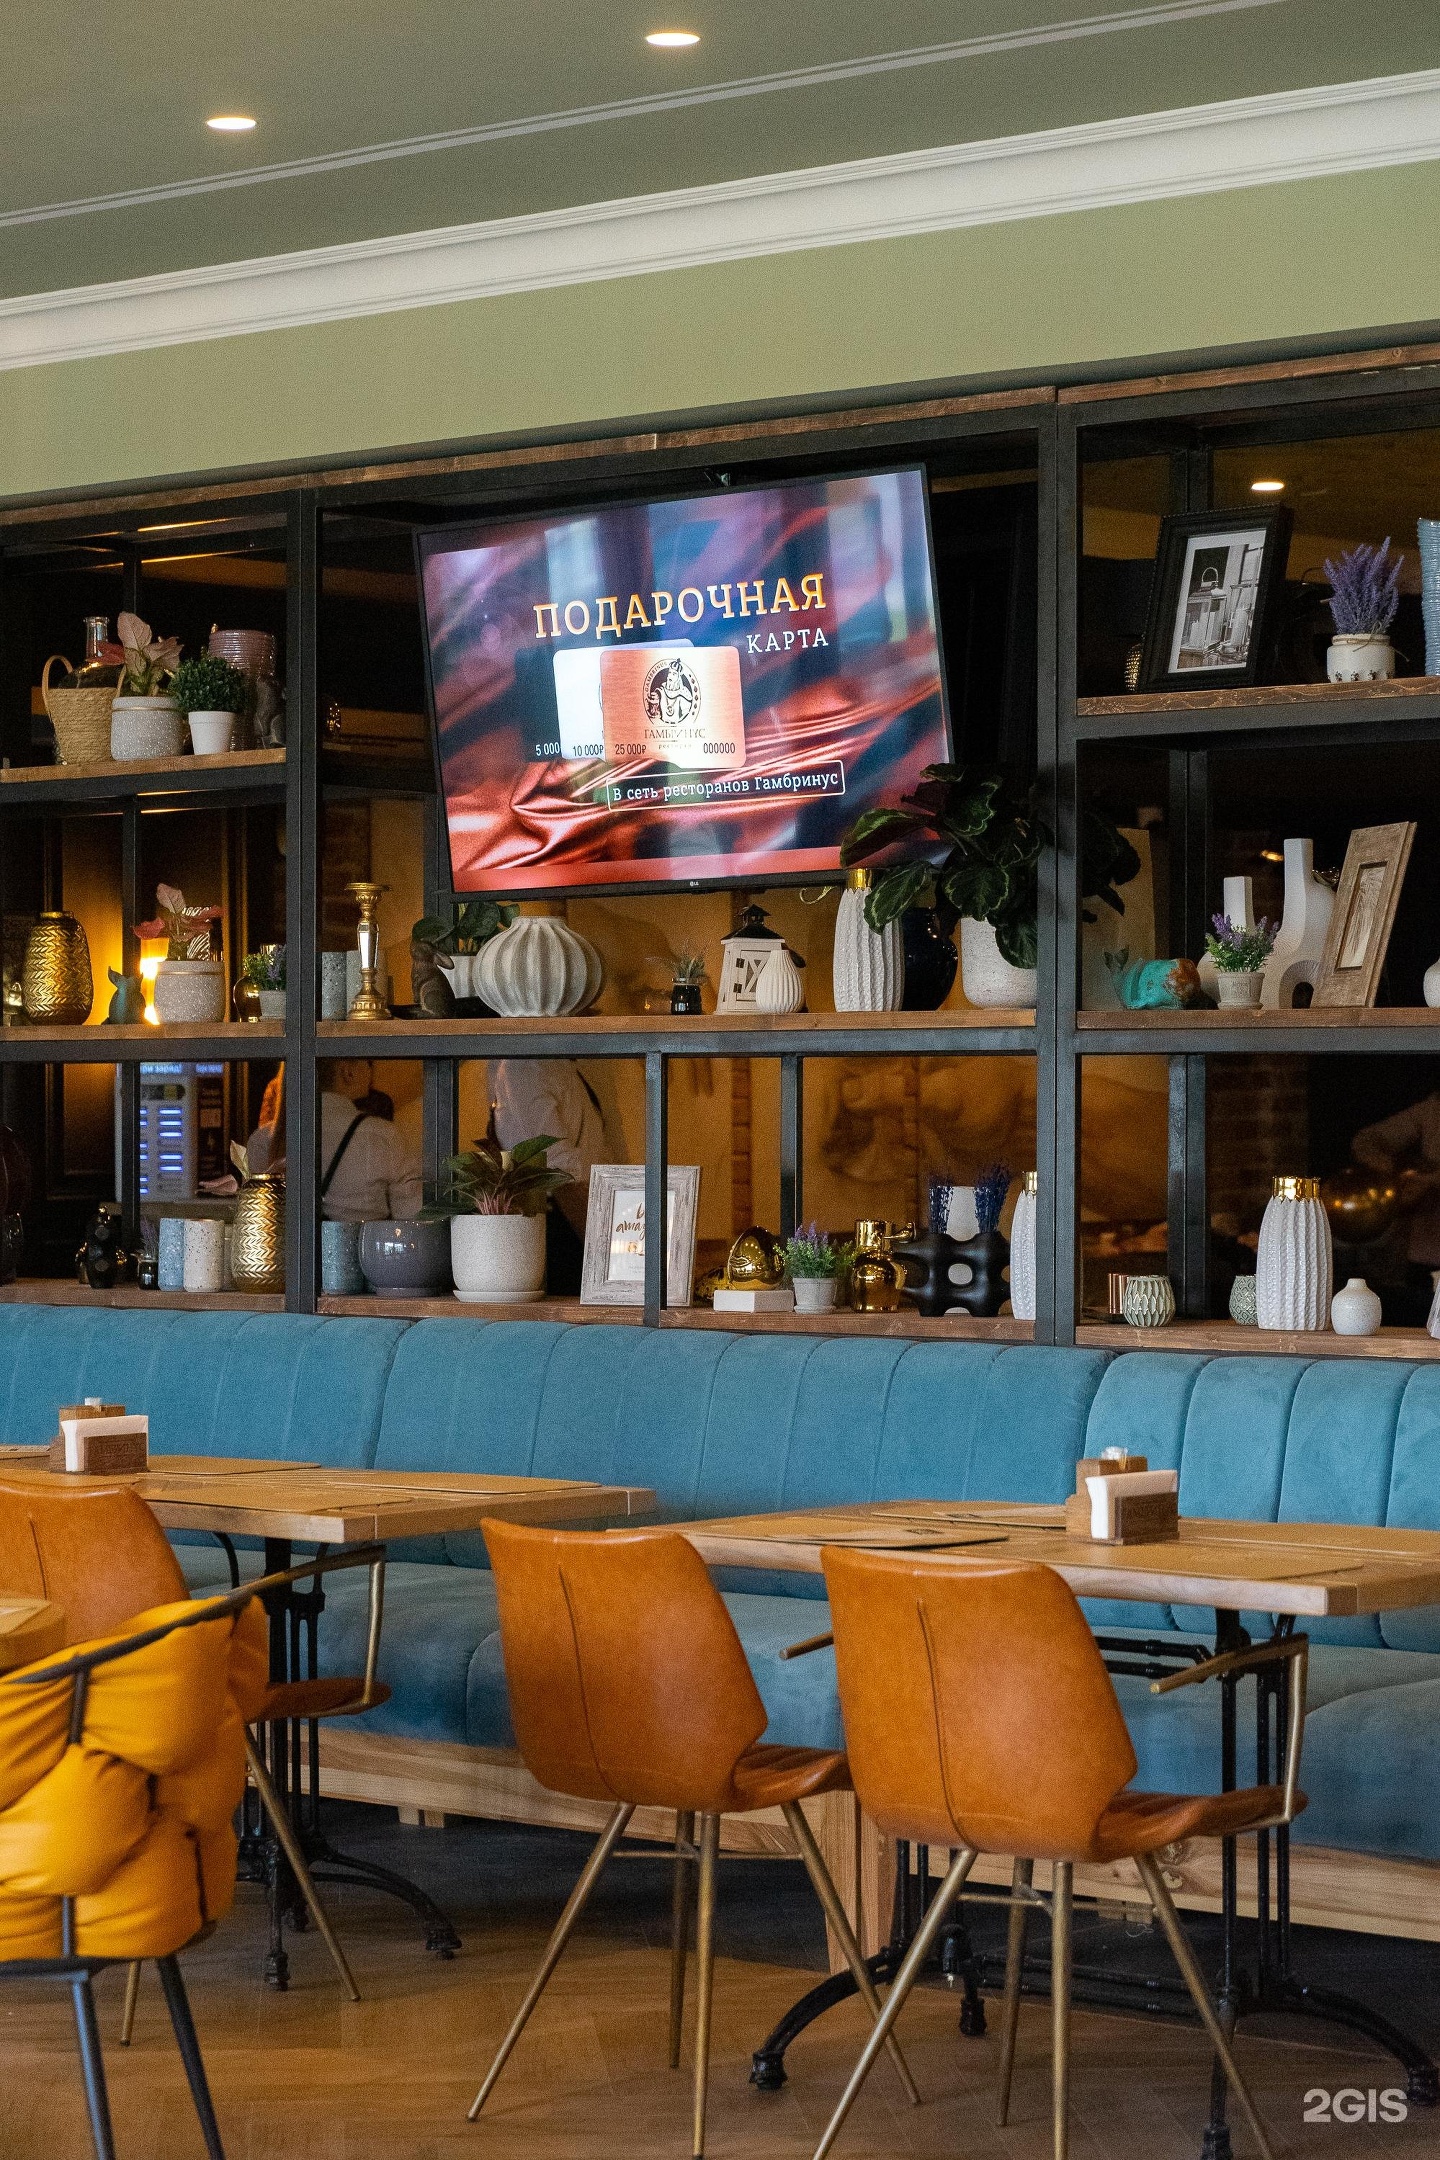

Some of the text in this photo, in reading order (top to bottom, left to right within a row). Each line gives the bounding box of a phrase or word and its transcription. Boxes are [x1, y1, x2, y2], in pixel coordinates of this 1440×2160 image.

[533, 573, 827, 639] ПОДАРОЧНАЯ
[746, 627, 829, 654] КАРТА
[535, 743, 542, 756] 5
[573, 744, 583, 757] 10
[614, 743, 625, 755] 25
[703, 742, 736, 754] 000000
[613, 772, 839, 802] В сеть ресторанов Гамбринус
[636, 1202, 645, 1219] b
